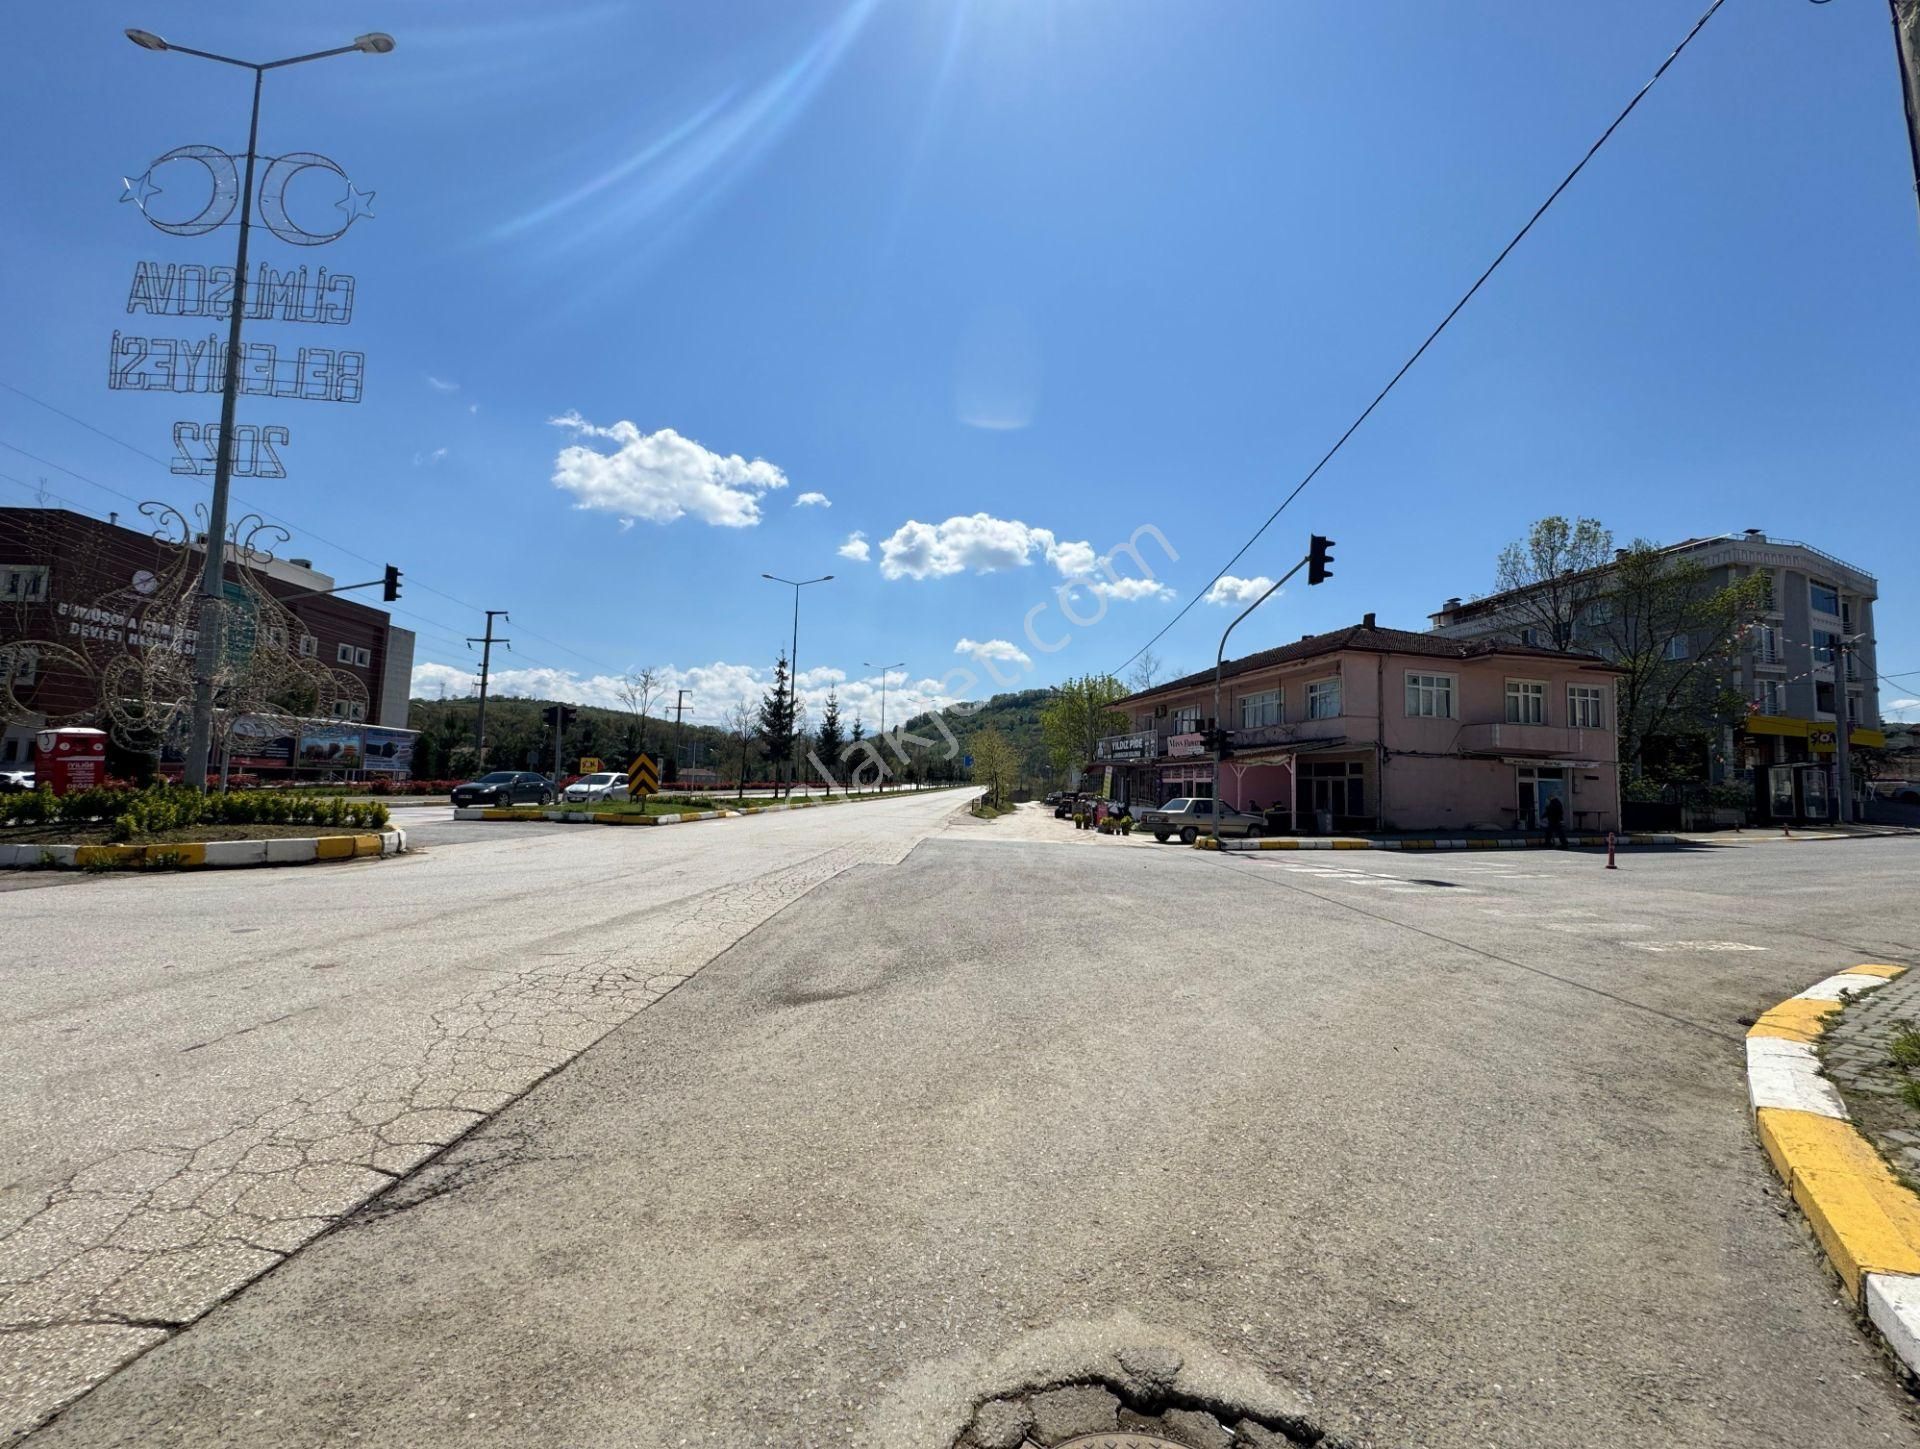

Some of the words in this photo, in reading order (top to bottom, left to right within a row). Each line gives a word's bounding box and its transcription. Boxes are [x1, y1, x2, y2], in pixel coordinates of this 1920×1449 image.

[69, 622, 123, 643] DEVLET
[128, 632, 197, 655] HASTAESİ
[1112, 740, 1129, 751] YILDIZ
